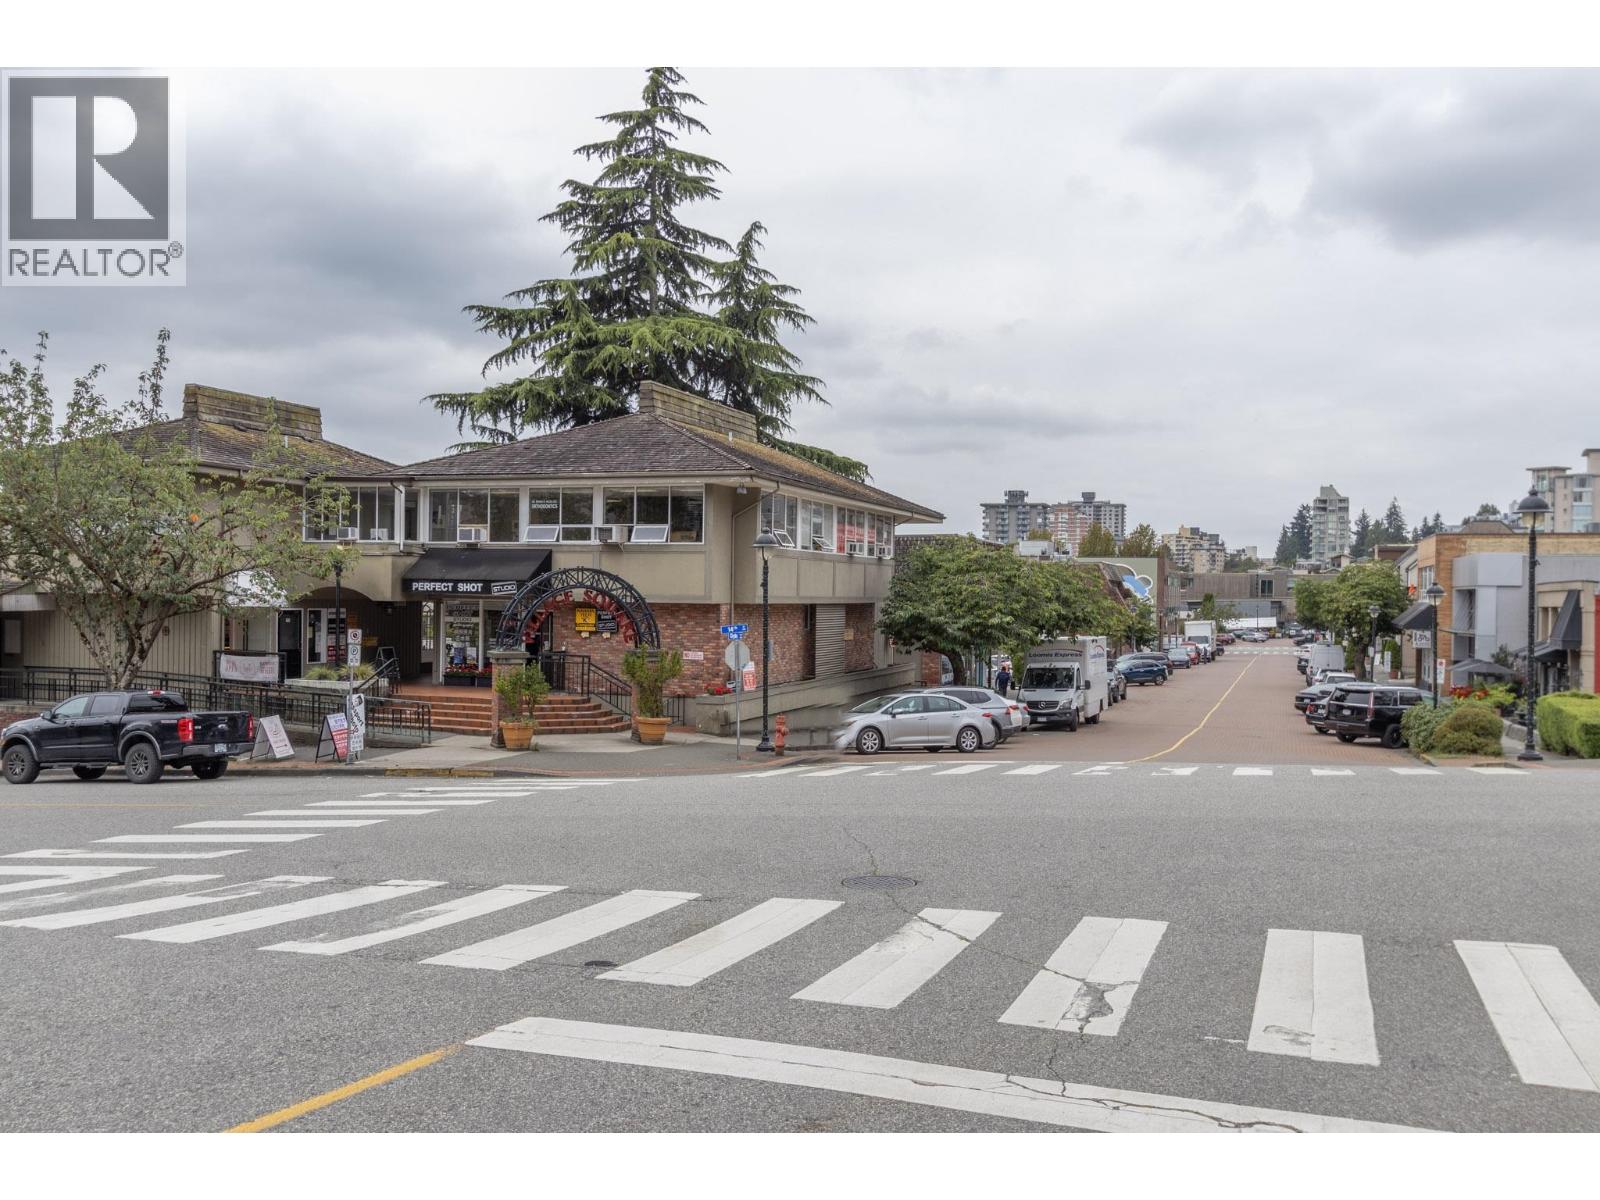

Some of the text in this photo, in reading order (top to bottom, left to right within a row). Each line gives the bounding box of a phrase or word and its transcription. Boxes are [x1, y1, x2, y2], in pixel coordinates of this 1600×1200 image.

[412, 582, 483, 592] PERFECT SHOT
[493, 584, 516, 593] STUDIO
[1054, 651, 1083, 659] Express
